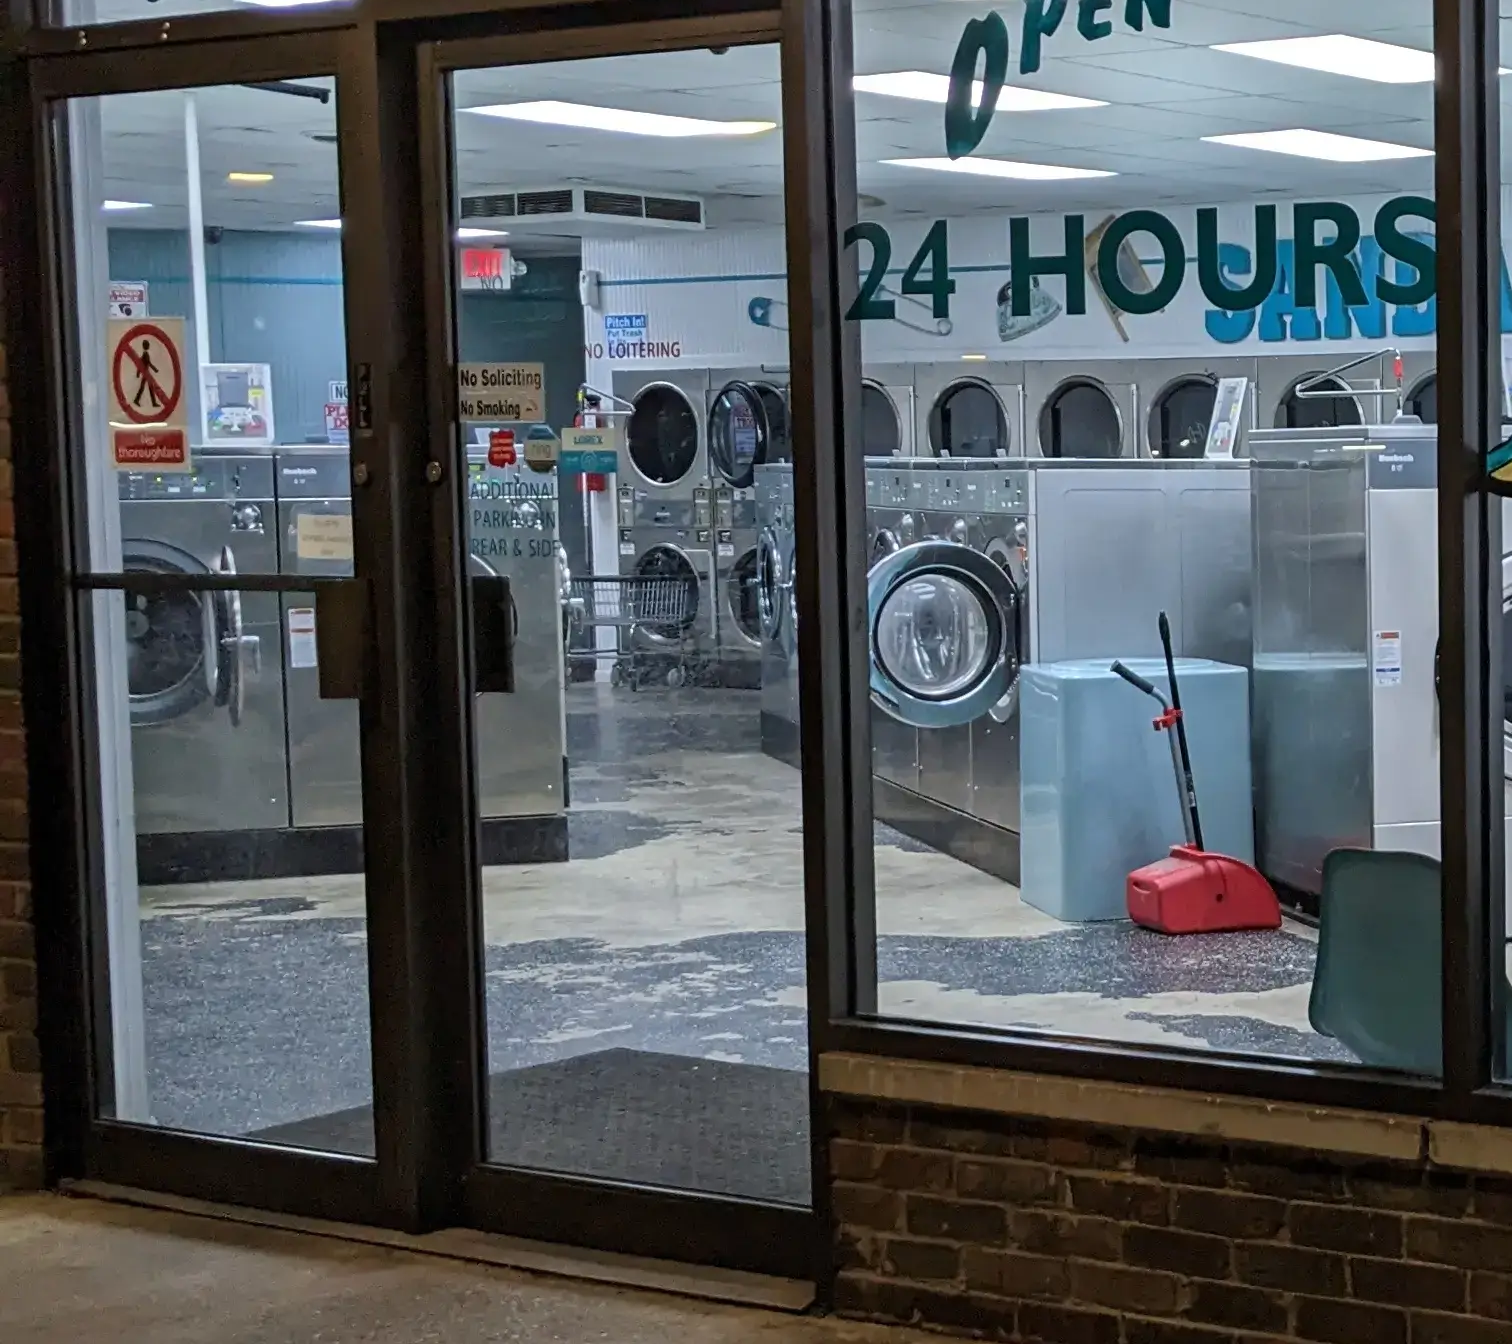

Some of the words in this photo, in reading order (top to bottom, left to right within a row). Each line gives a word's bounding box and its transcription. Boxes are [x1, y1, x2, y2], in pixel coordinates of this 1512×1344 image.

[845, 217, 957, 321] 24
[1009, 194, 1437, 318] HOURS
[606, 316, 630, 328] Pitch
[583, 343, 603, 359] NO
[608, 341, 681, 359] LOITERING
[460, 369, 478, 386] No
[481, 368, 542, 390] Soliciting
[460, 400, 474, 416] No
[477, 400, 521, 419] Smoking
[118, 446, 181, 462] thoroughfare
[471, 480, 558, 501] ADDITIONAL
[471, 537, 508, 557] REAR
[513, 538, 522, 557] &
[529, 539, 561, 558] SIDE
